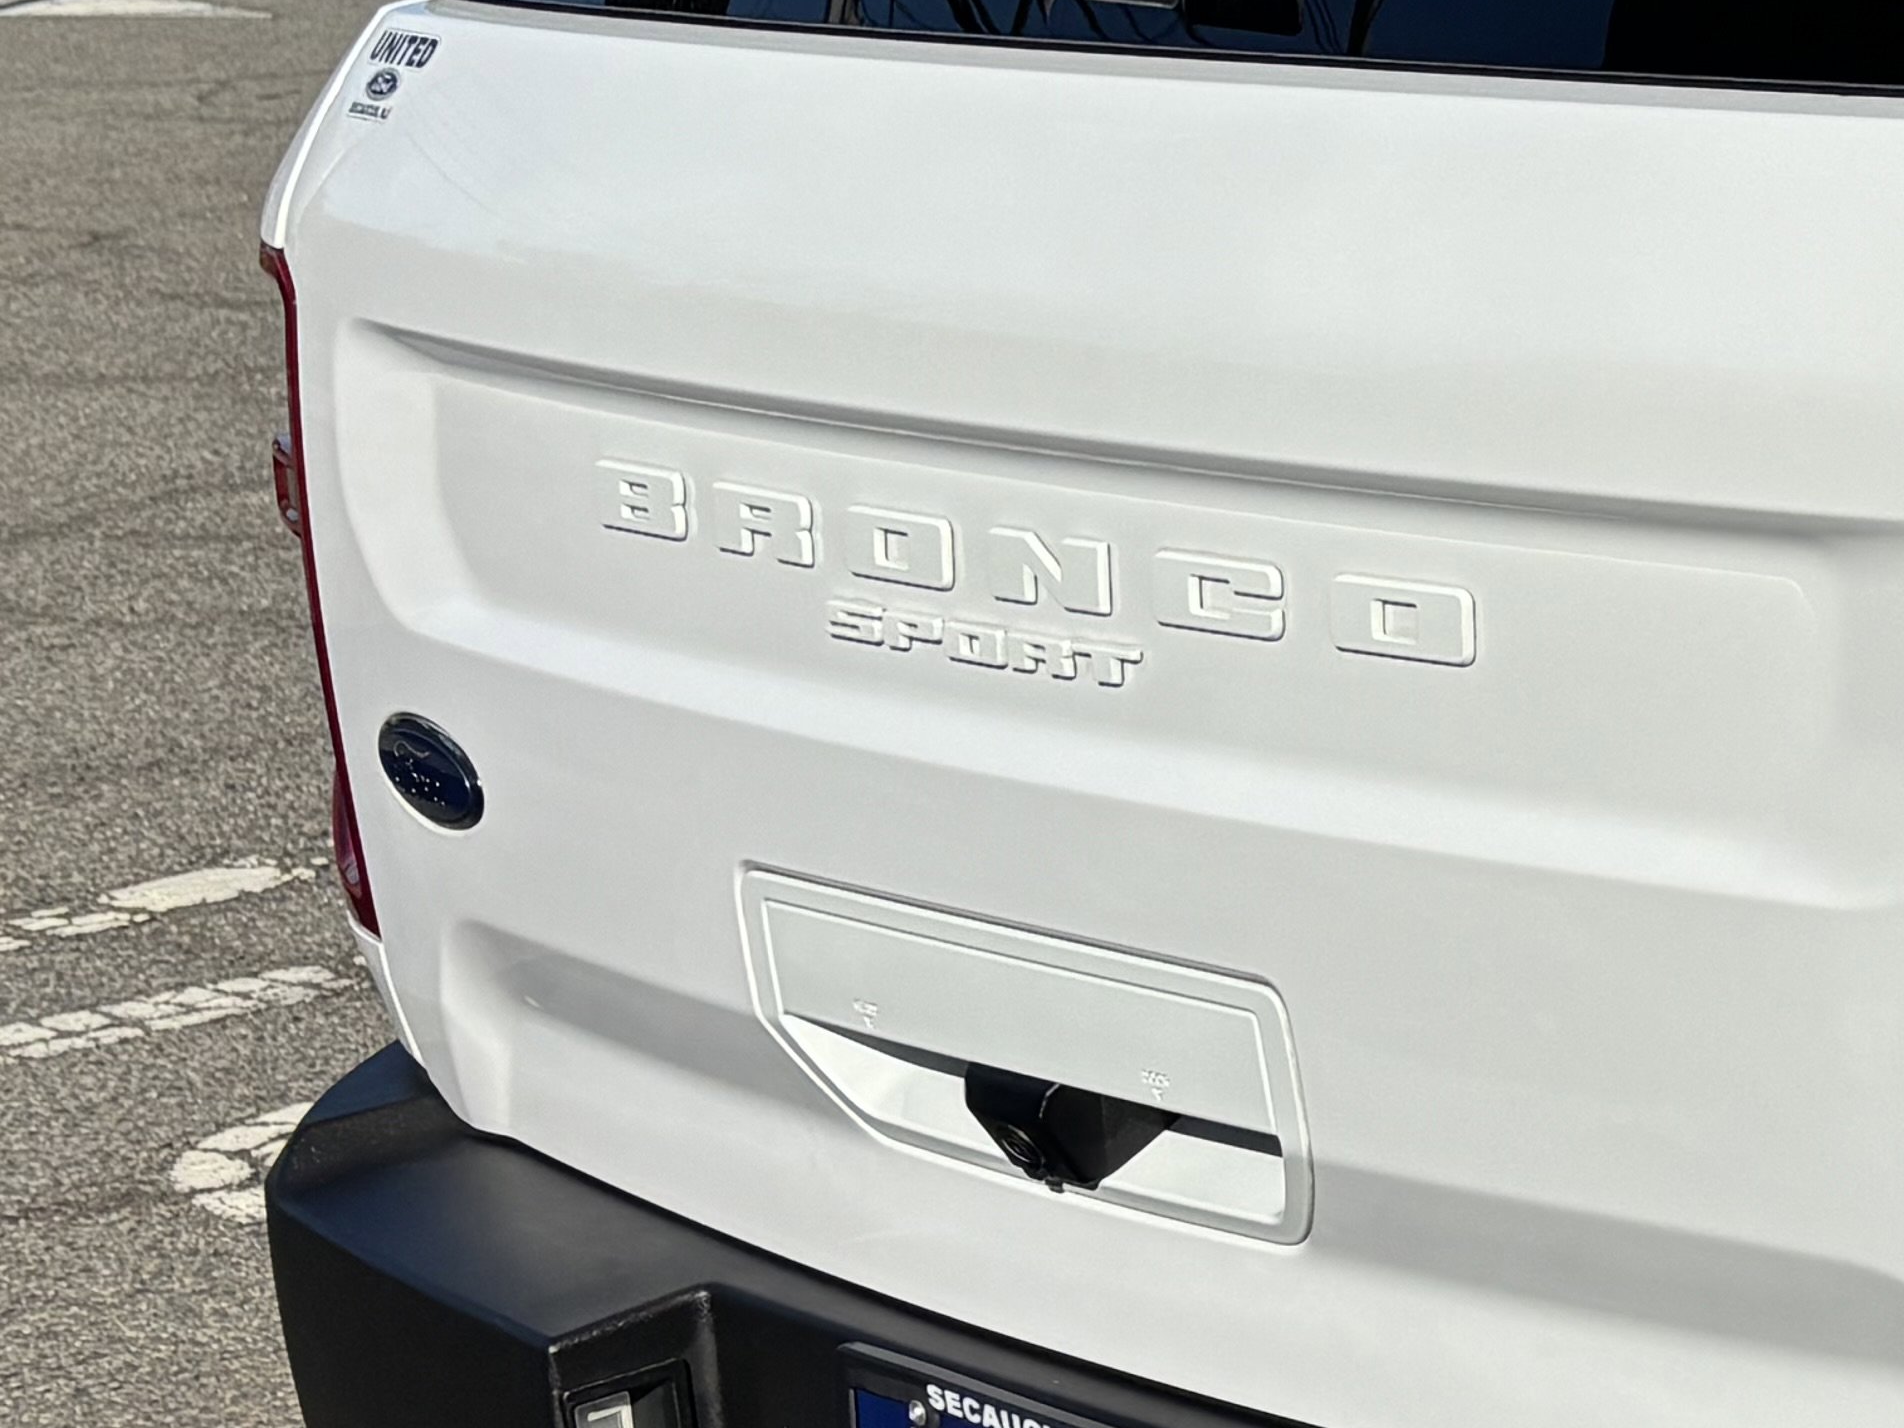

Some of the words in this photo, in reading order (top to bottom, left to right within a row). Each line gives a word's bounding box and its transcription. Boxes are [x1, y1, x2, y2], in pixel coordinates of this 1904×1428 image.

[370, 29, 439, 69] UNITED
[594, 457, 1478, 668] BRONCO
[824, 595, 1145, 688] SPORT
